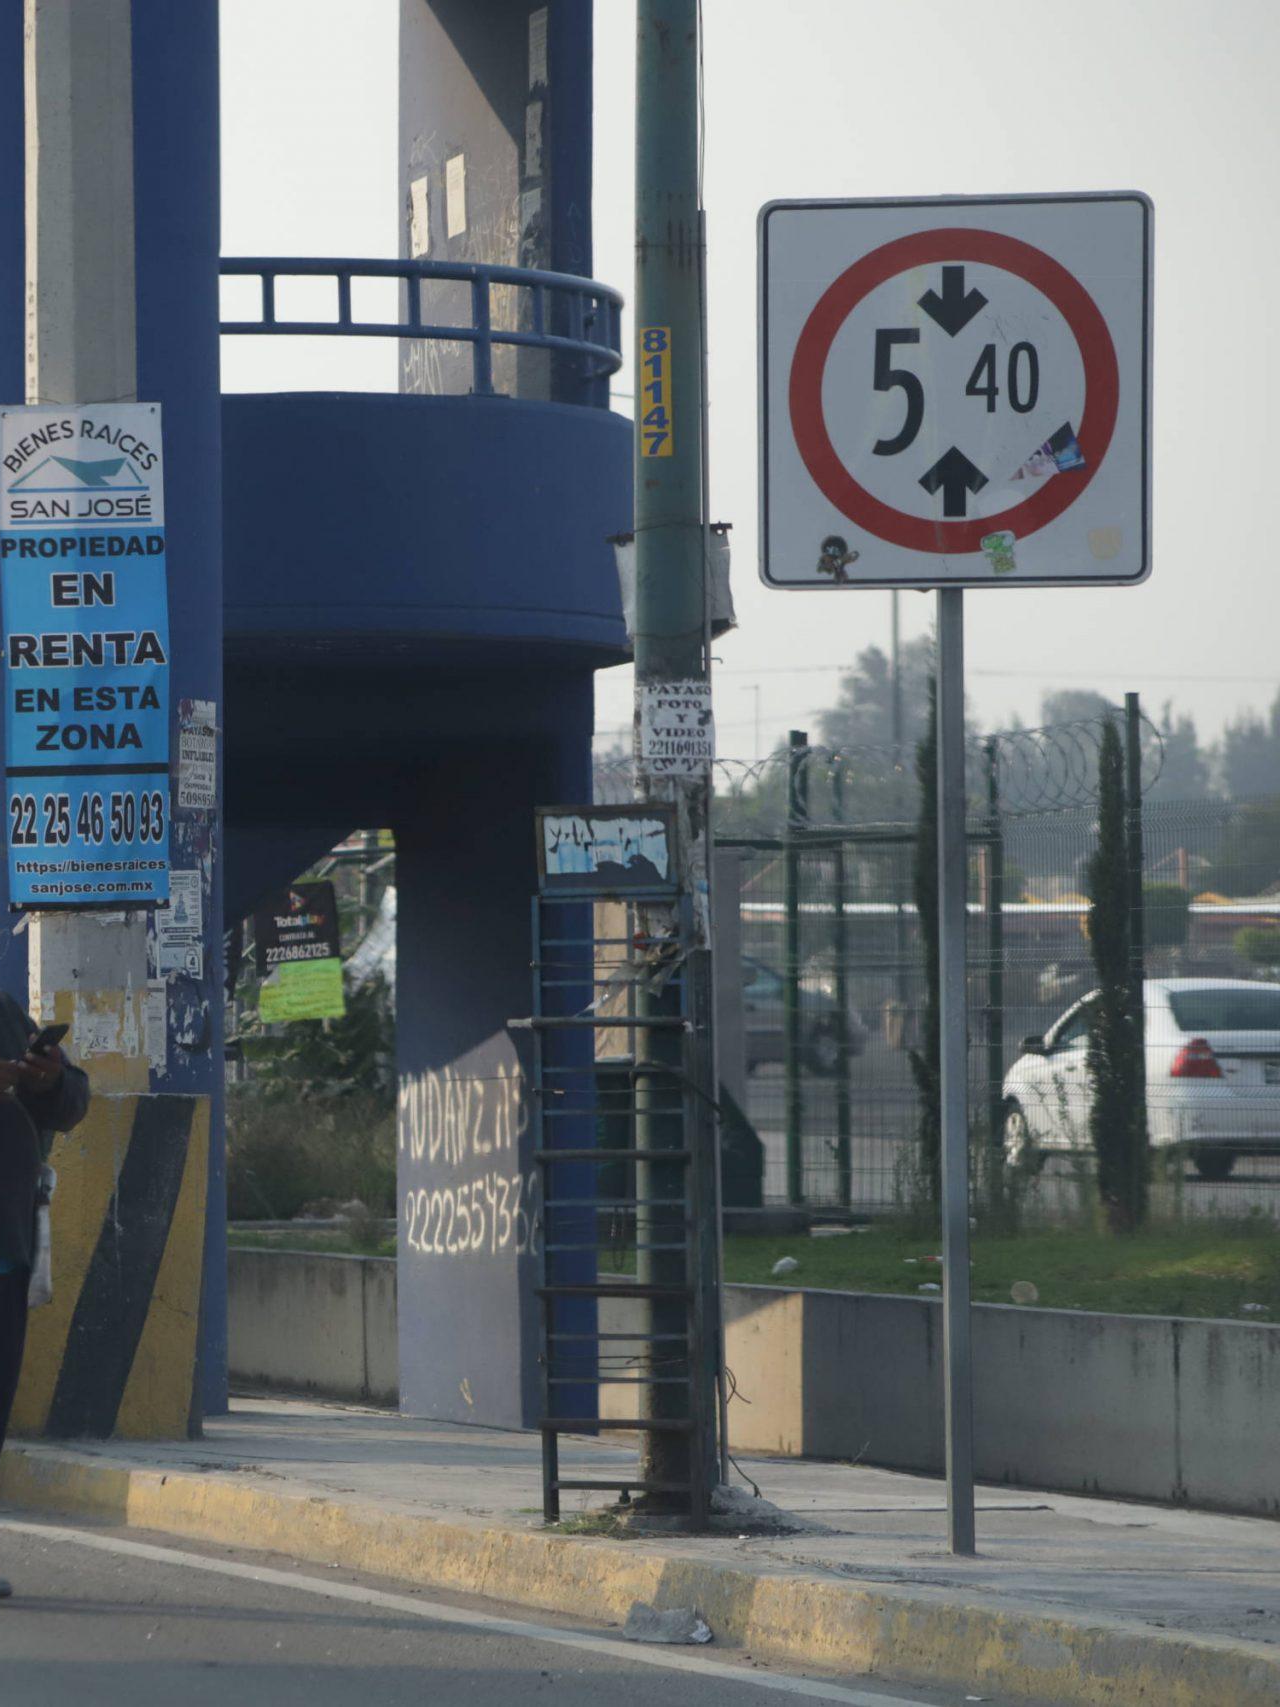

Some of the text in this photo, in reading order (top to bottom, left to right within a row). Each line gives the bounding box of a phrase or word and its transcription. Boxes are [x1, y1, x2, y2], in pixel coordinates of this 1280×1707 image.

[642, 328, 670, 455] 81147
[872, 328, 1040, 457] 5 40
[3, 419, 158, 473] BIENES RAICES
[10, 494, 152, 518] SAN JOSÉ
[1, 535, 165, 558] PROPIEDAD
[52, 573, 114, 606] EN
[8, 632, 166, 667] RENTA
[14, 686, 160, 712] EN ESTA
[657, 699, 702, 709] FOTO
[675, 713, 688, 723] Y
[36, 723, 142, 751] ZONA
[652, 728, 706, 738] VIDEO
[11, 792, 164, 845] 22 25 46 50 93
[16, 859, 166, 875] https://bienesraices
[31, 881, 153, 896] sanjose.com.mx
